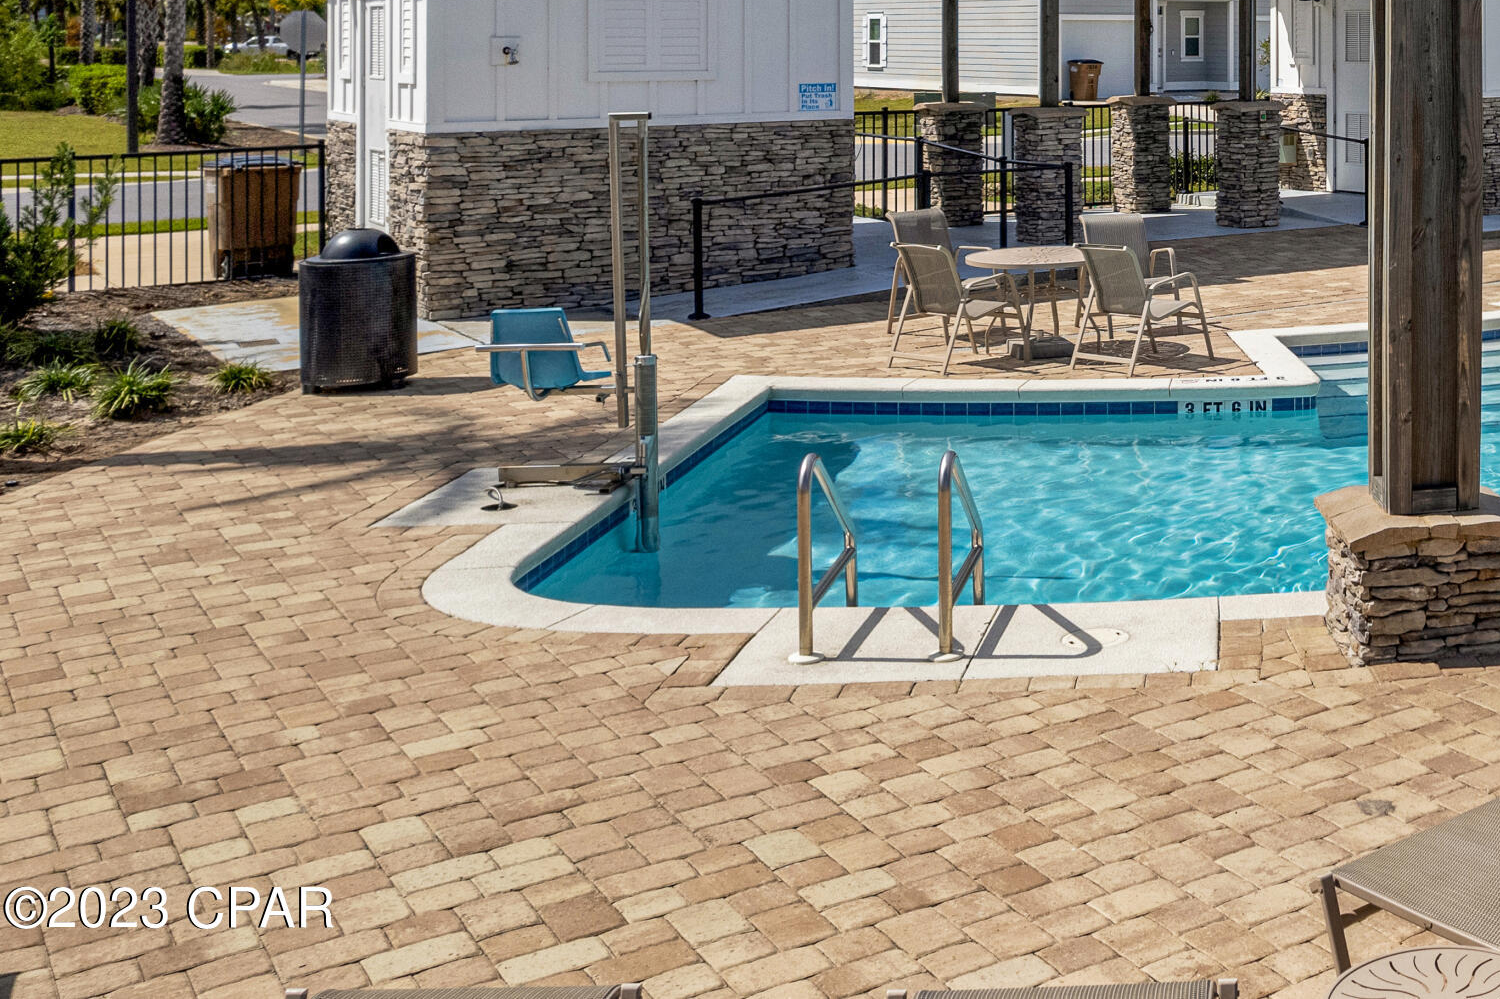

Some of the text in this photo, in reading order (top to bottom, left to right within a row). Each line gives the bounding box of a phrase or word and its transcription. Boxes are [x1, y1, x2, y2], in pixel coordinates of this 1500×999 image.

[801, 83, 835, 92] Pitch In!
[1185, 403, 1194, 413] 3
[1203, 402, 1223, 412] FT
[1249, 401, 1266, 411] IN
